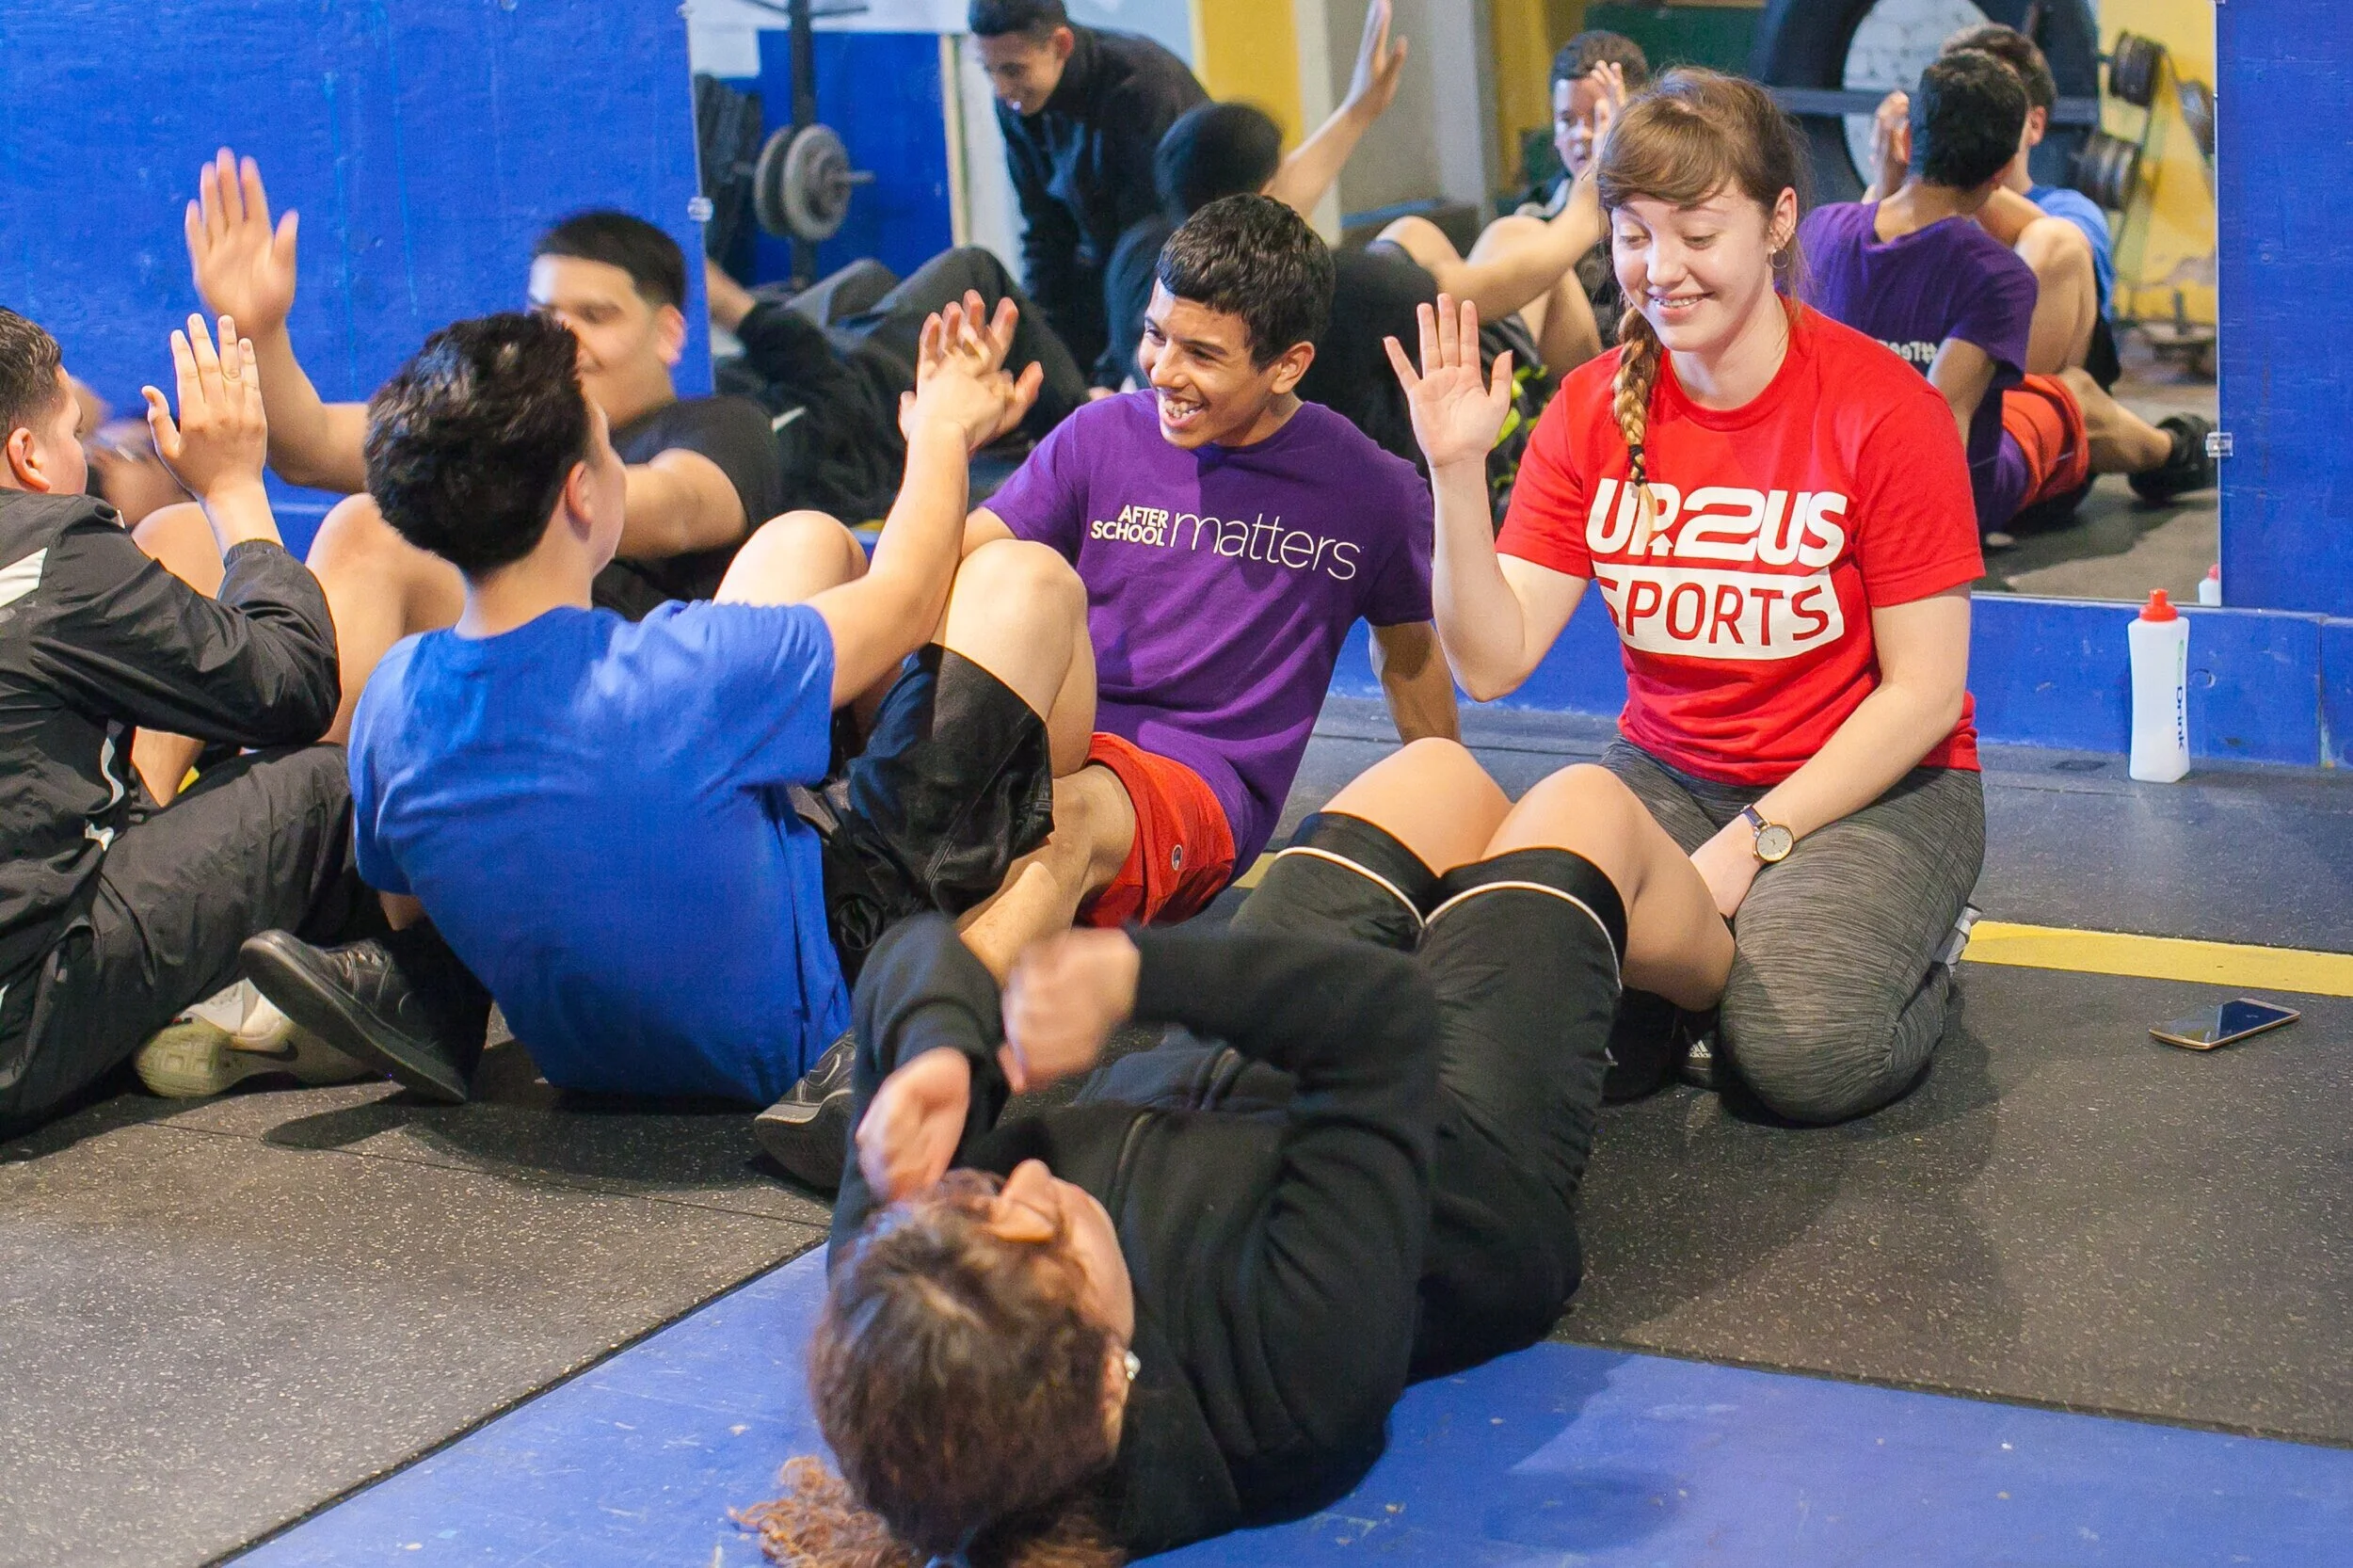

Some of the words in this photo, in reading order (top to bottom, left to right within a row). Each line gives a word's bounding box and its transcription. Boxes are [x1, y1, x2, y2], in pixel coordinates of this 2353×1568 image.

[1090, 520, 1165, 547] SCHOOL
[1117, 504, 1169, 529] AFTER
[1585, 477, 1849, 568] UR2US
[1170, 513, 1361, 580] matters
